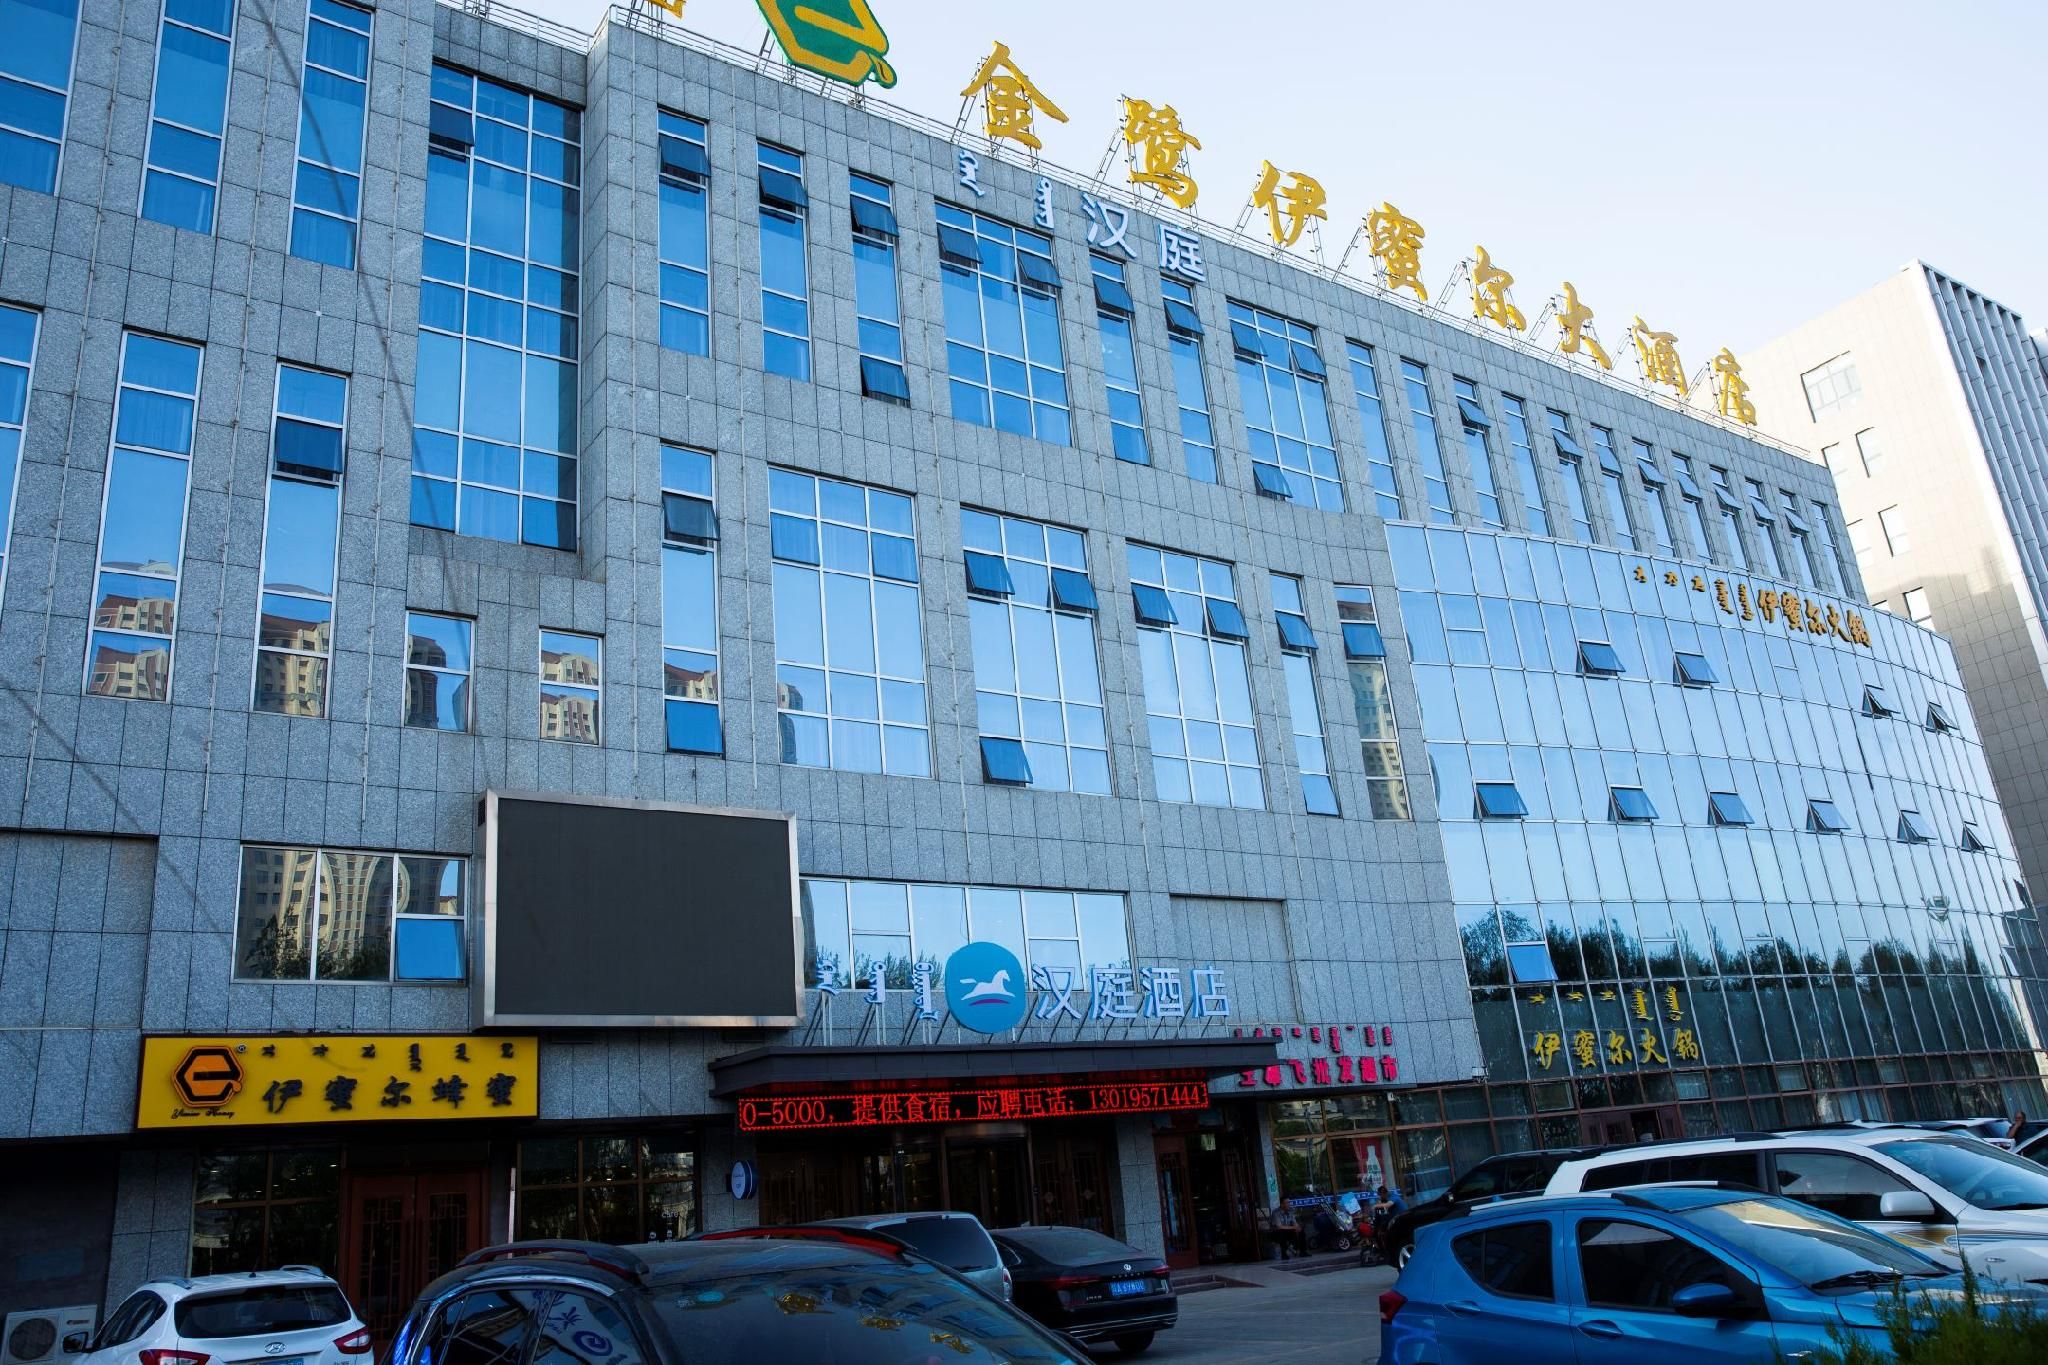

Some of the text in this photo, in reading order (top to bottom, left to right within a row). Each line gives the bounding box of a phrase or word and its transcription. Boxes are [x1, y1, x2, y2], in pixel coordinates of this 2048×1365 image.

[1080, 191, 1206, 282] 汉庭
[1032, 963, 1230, 1020] 汉庭酒店
[1532, 1027, 1699, 1070] 伊蜜尔火锅
[262, 1073, 518, 1114] 伊蜜尔蜂蜜
